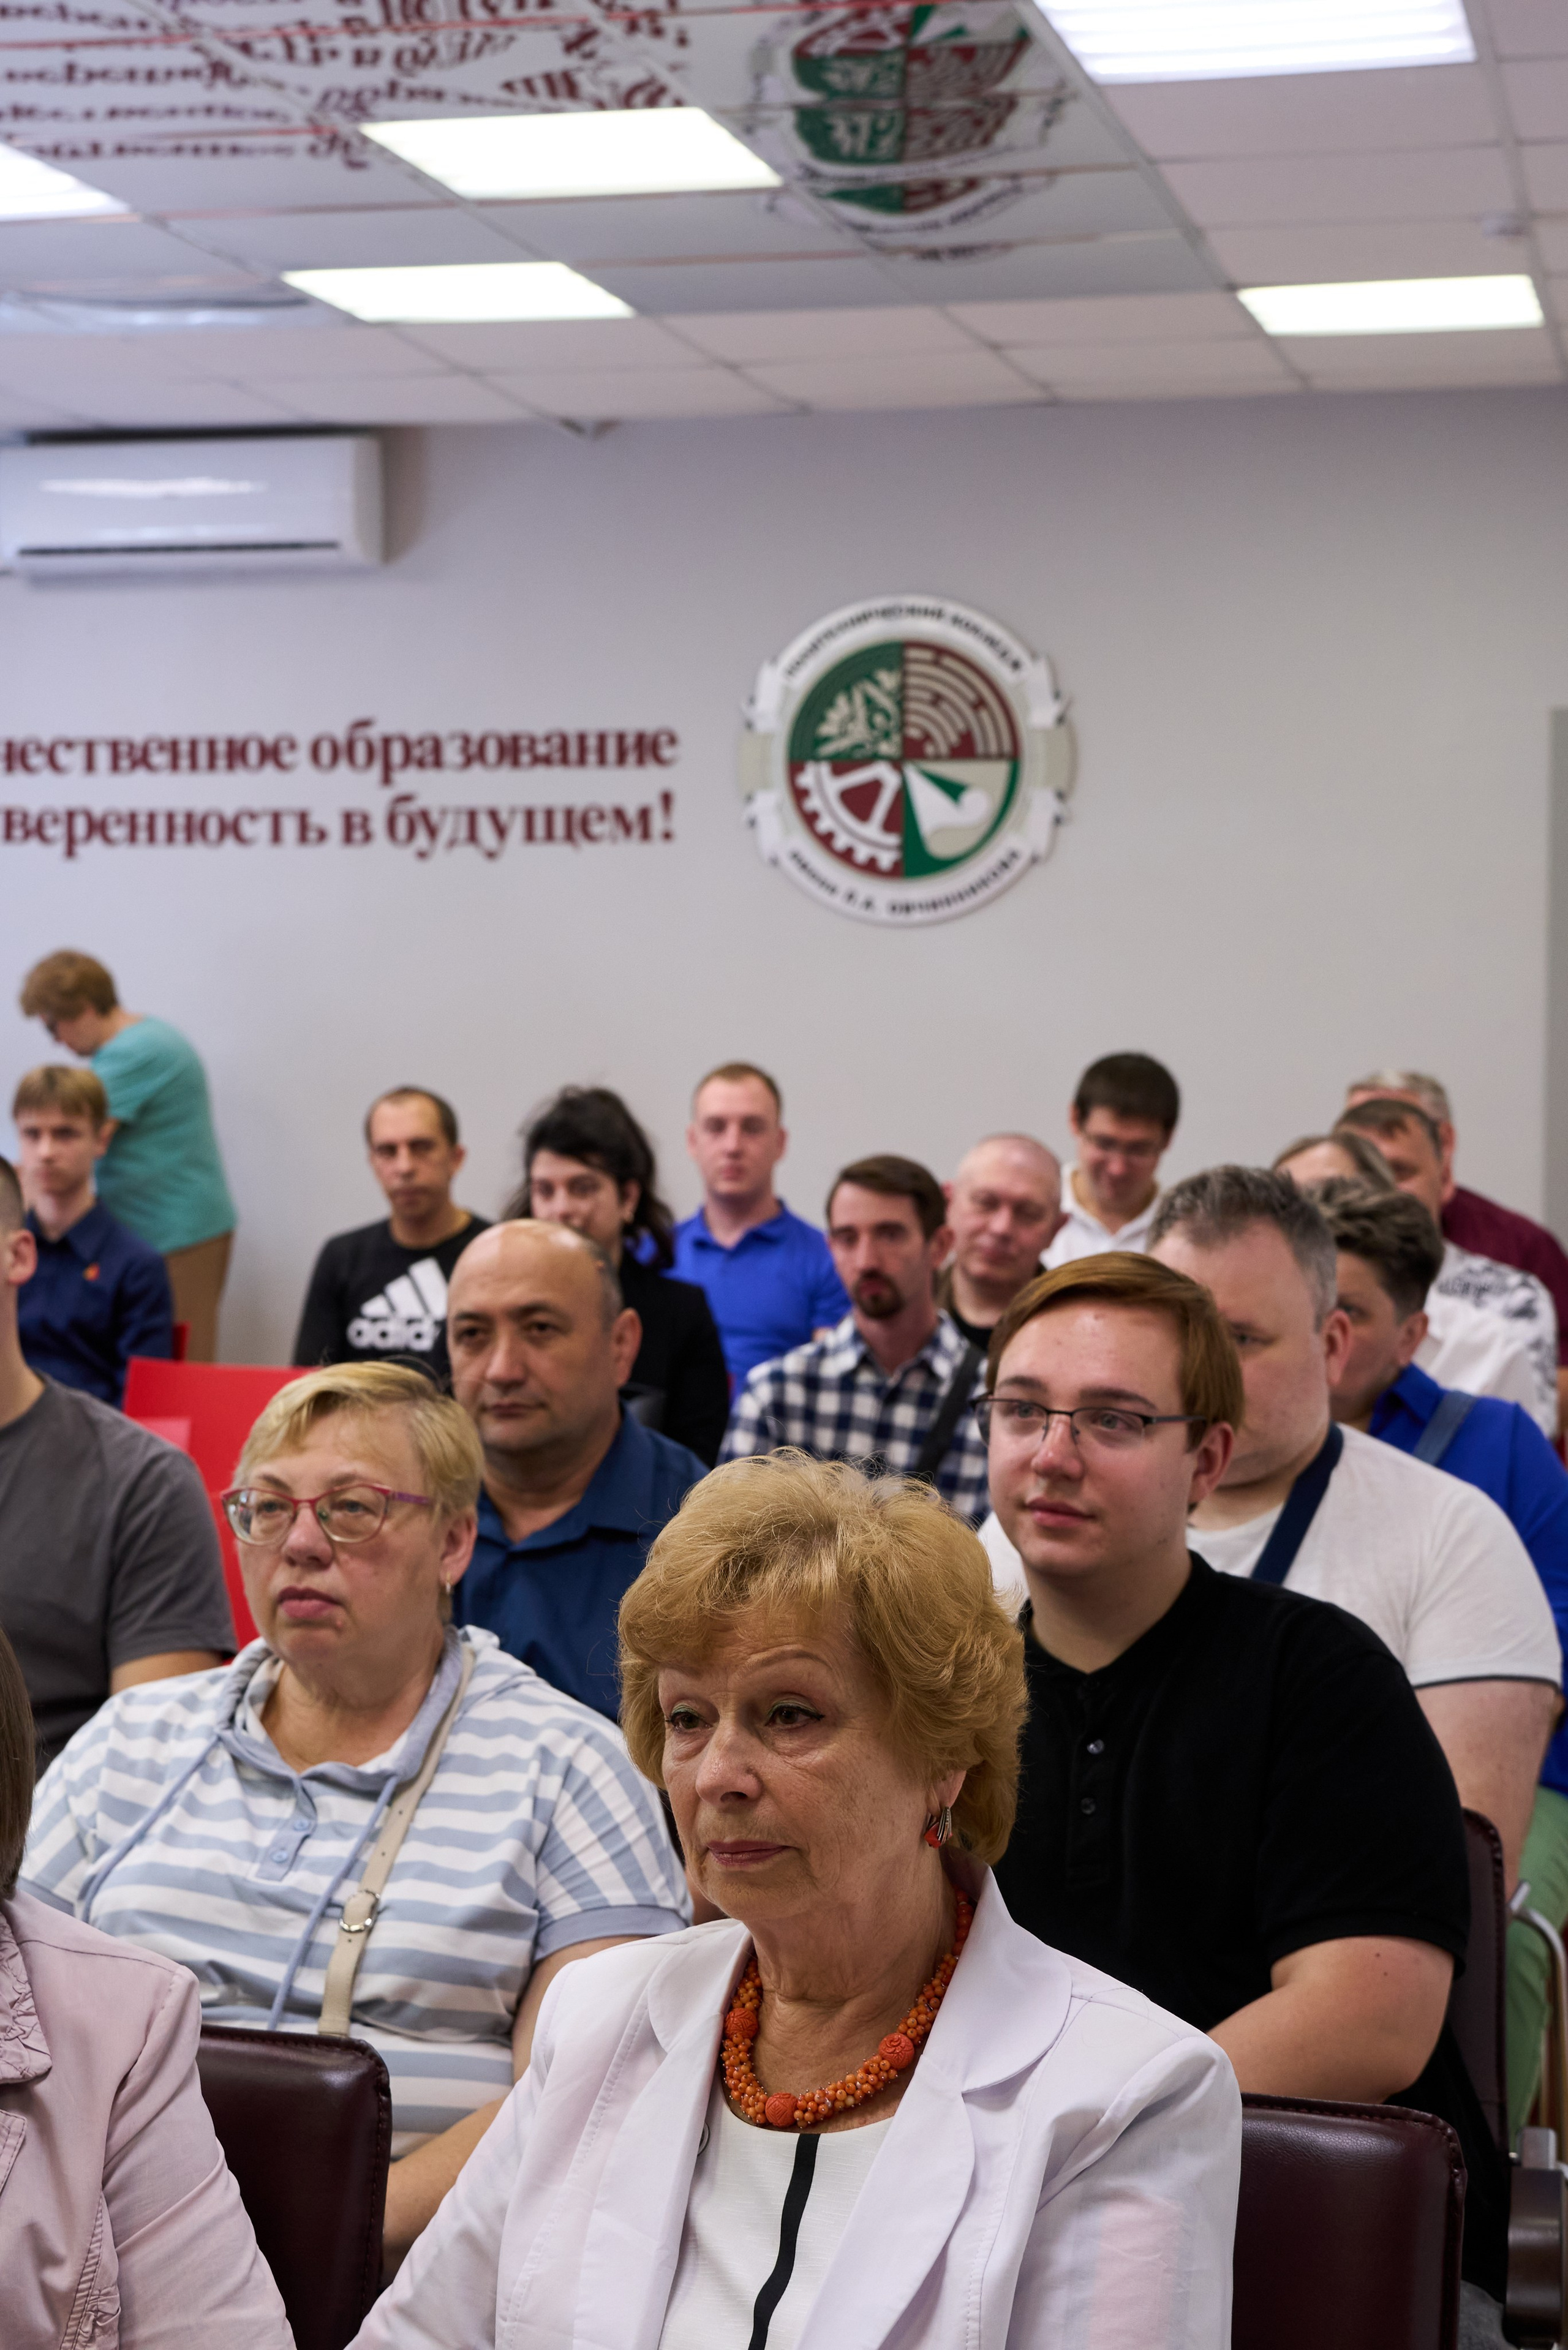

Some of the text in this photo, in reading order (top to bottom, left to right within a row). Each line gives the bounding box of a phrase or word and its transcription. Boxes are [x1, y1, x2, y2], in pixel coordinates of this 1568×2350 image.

[308, 718, 679, 786] образование
[340, 808, 374, 846] в
[385, 789, 674, 861] будущем!
[346, 1316, 442, 1352] adid
